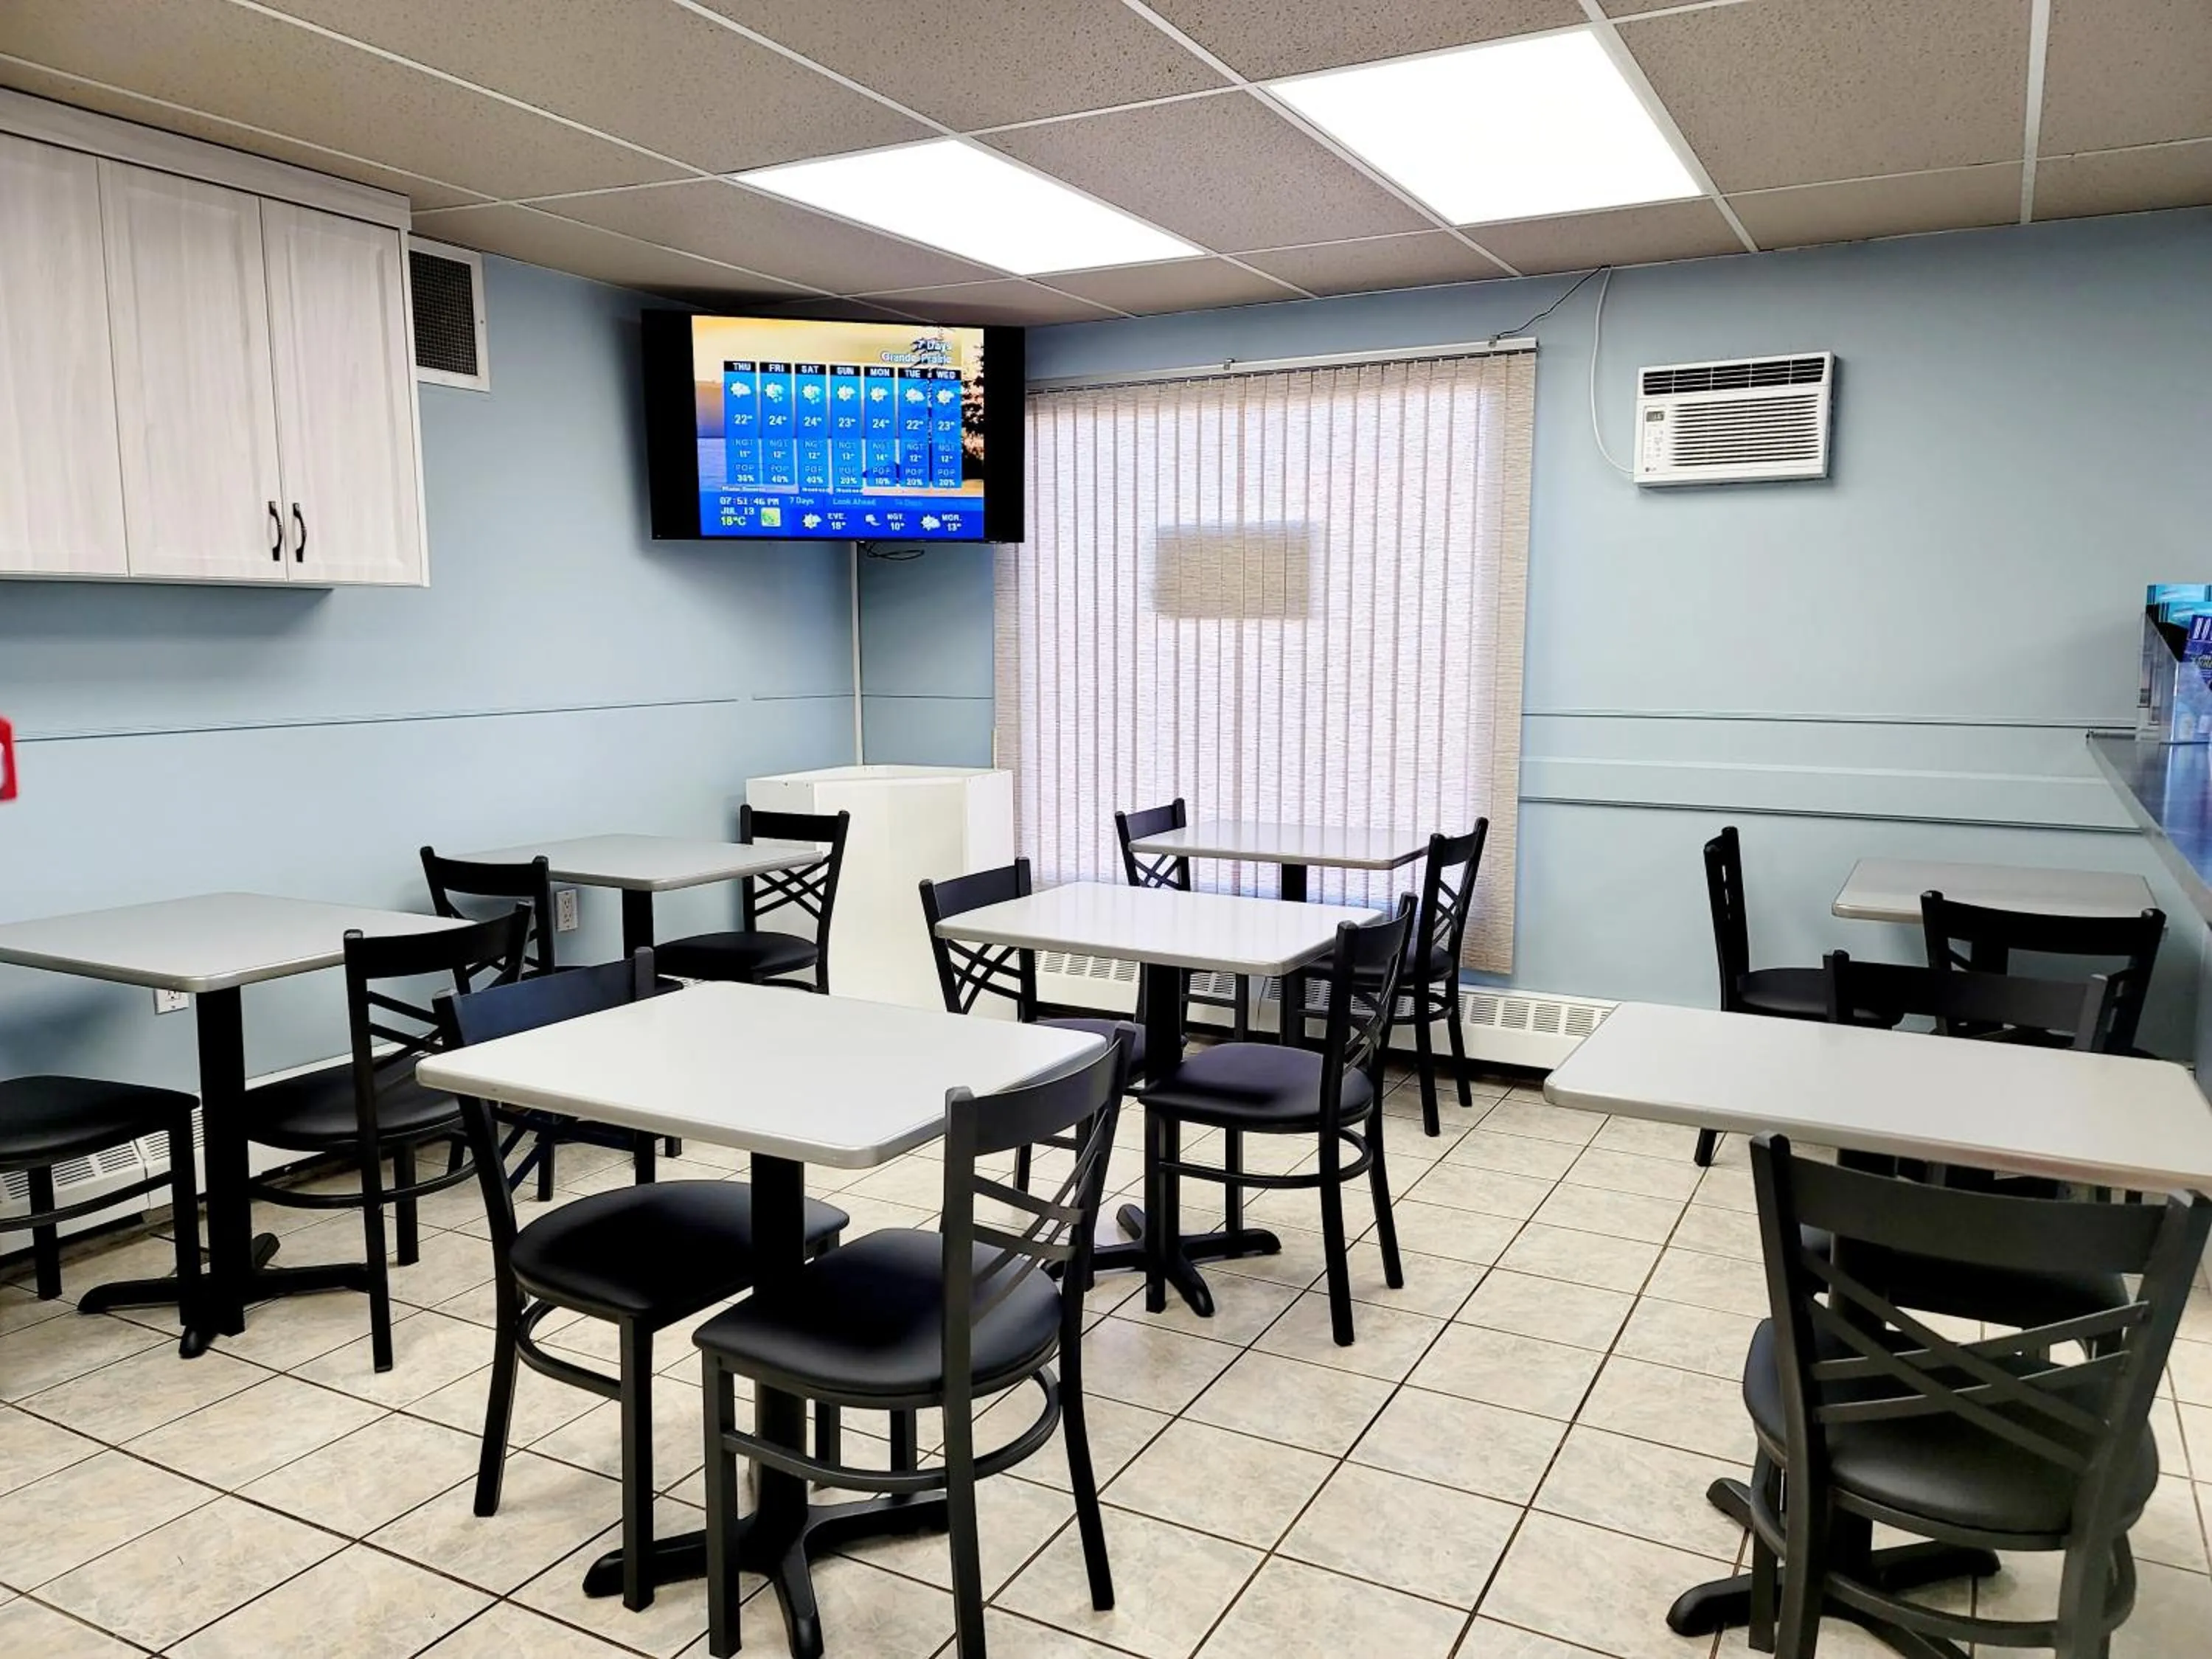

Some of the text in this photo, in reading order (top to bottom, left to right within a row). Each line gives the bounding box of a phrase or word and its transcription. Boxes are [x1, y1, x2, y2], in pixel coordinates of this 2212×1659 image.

[927, 341, 951, 352] Days
[881, 352, 918, 362] Grande
[733, 363, 751, 371] THU
[769, 364, 785, 372] FRI
[801, 366, 819, 374] SAT
[837, 367, 854, 375] SUN
[870, 369, 890, 377] MON
[936, 371, 956, 379] WED
[796, 497, 815, 506] Days
[720, 507, 755, 516] JUL 13
